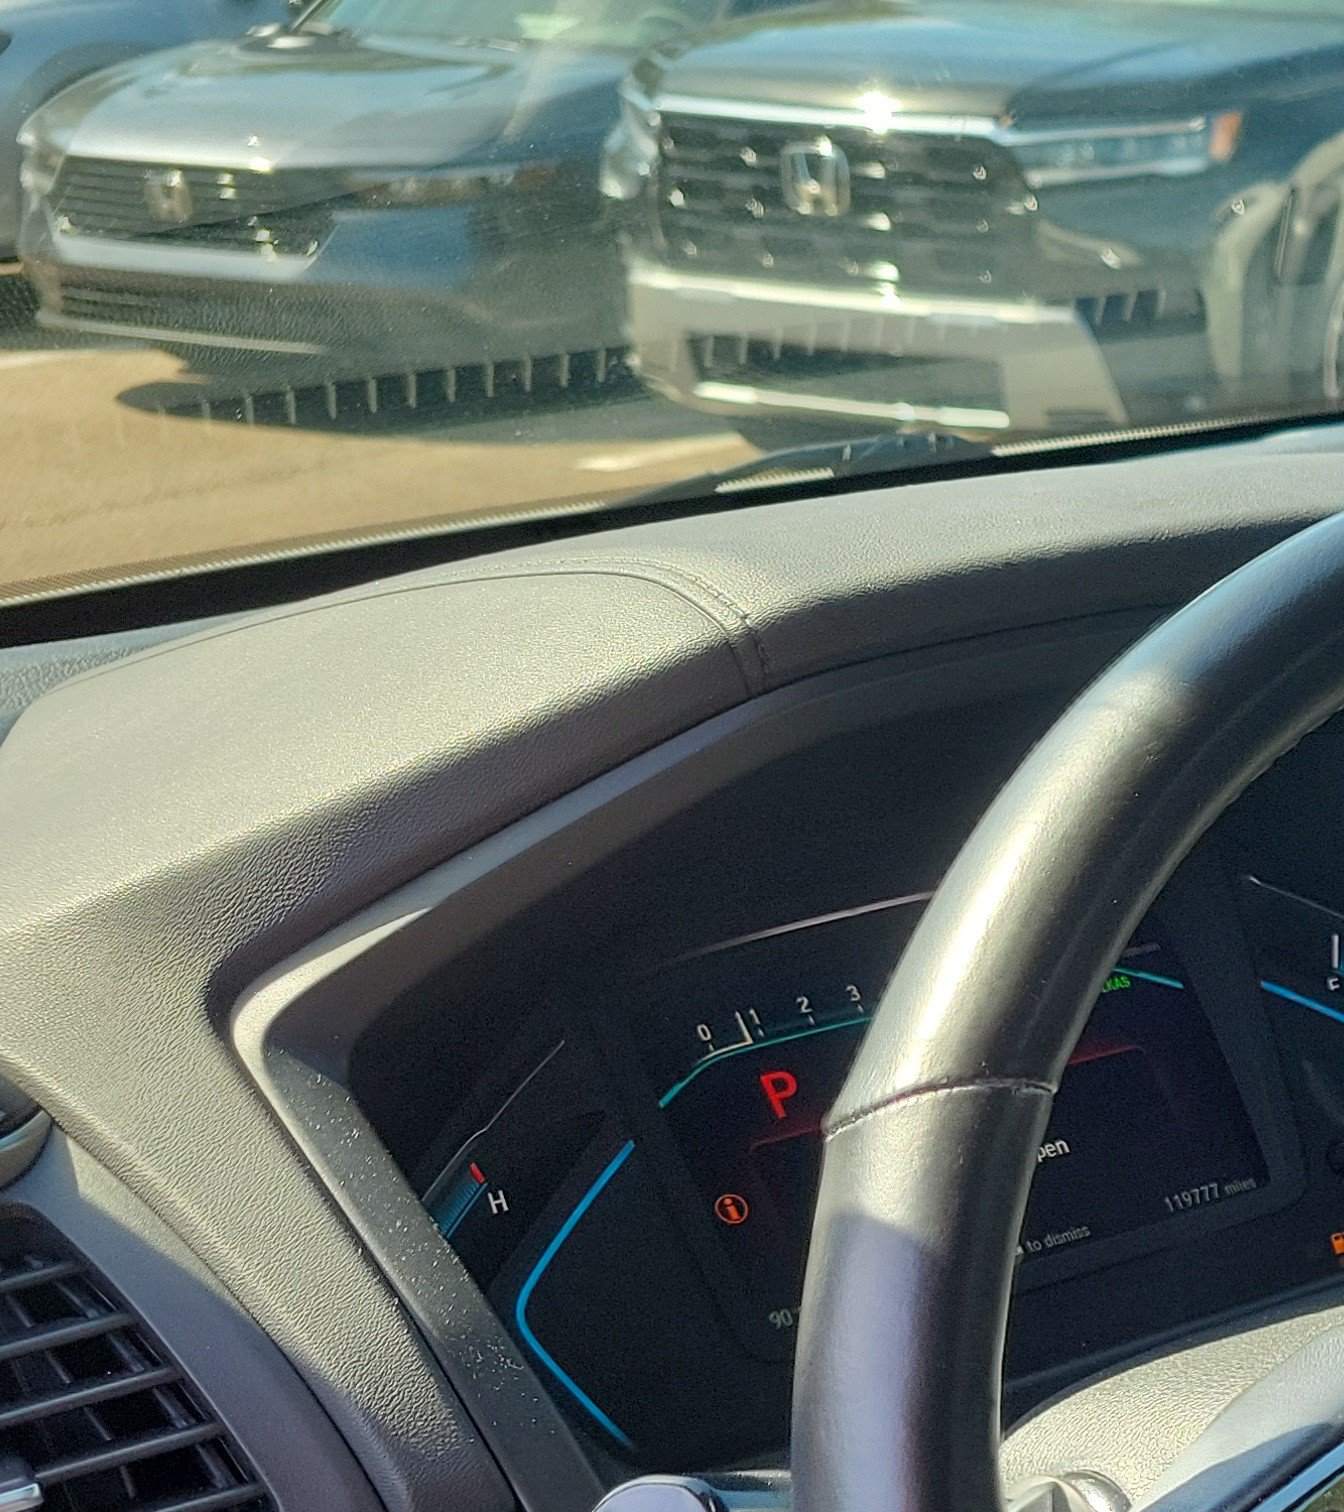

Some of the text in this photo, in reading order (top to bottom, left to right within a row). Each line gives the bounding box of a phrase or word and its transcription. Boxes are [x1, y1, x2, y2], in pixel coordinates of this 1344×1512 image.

[698, 1023, 712, 1041] 0
[796, 997, 811, 1013] 2
[846, 984, 860, 1001] 3
[760, 1071, 797, 1118] P
[488, 1190, 508, 1214] H
[1163, 1177, 1257, 1213] 119777 miles
[1027, 1225, 1091, 1252] to dismiss
